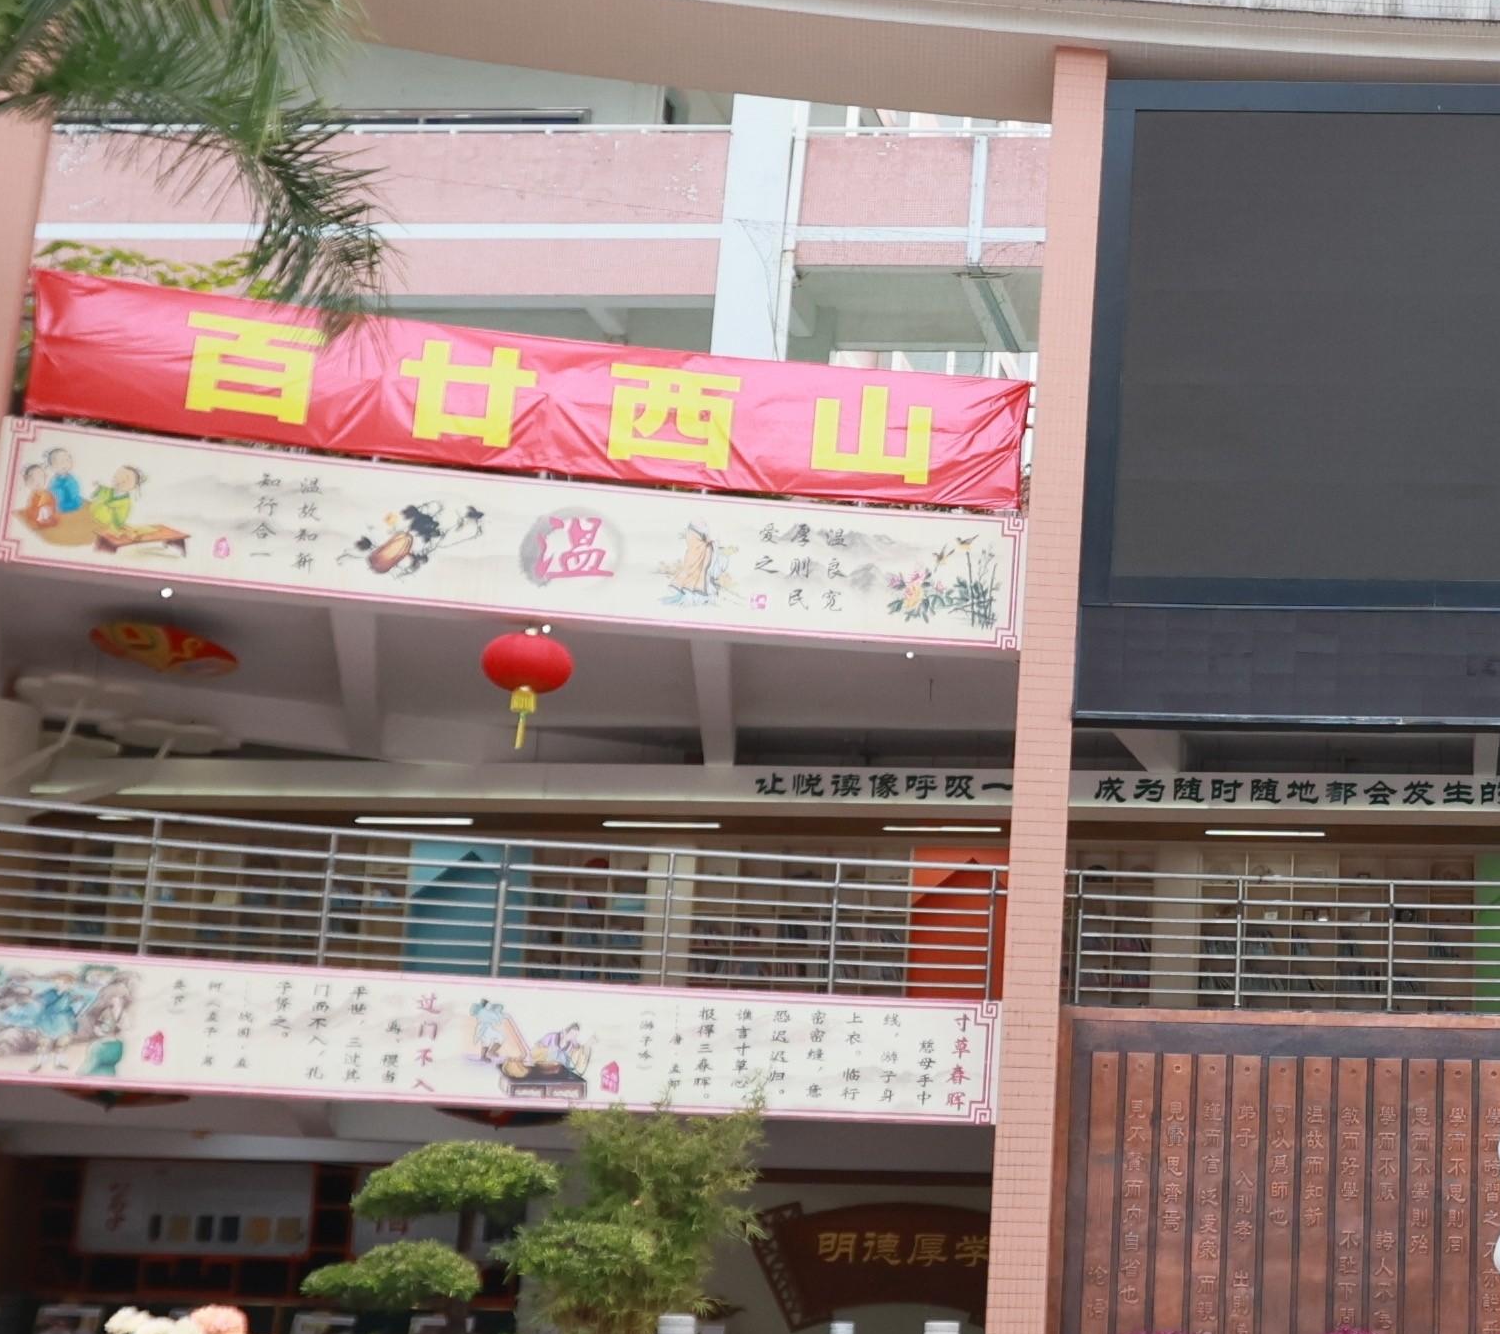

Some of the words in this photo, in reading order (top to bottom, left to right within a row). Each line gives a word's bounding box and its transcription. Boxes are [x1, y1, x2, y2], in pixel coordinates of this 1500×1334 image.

[184, 311, 936, 487] 百廿西山
[250, 472, 281, 557] 知行合一
[533, 513, 616, 582] 温
[755, 771, 1014, 800] 让悦读像呼吸一
[916, 1039, 936, 1106] 慈母手中
[946, 1013, 971, 1111] 寸草春晖
[816, 1231, 990, 1268] 明德厚学
